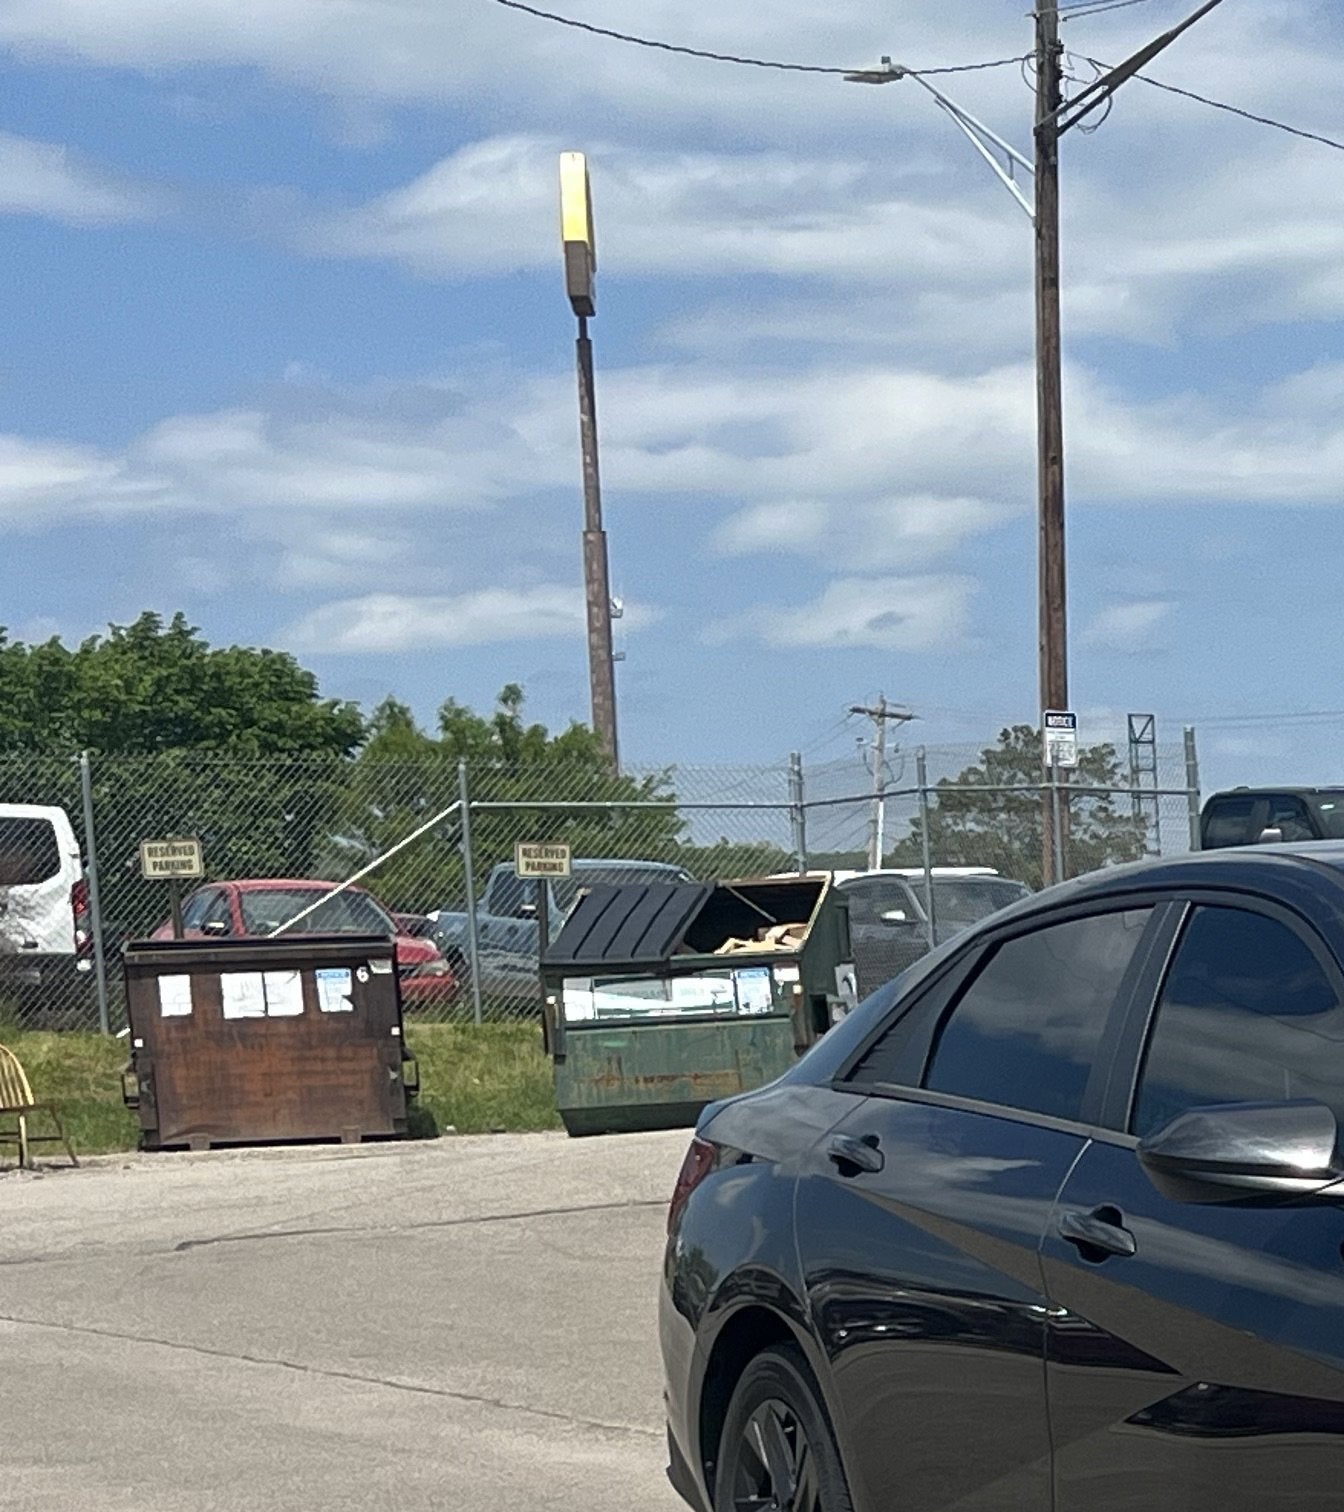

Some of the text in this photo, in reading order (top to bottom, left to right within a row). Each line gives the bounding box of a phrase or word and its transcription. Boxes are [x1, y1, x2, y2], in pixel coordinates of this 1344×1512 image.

[146, 845, 195, 858] RESERVED
[522, 847, 567, 859] RESERVED
[152, 859, 194, 871] PARKING
[525, 861, 564, 872] PARKING
